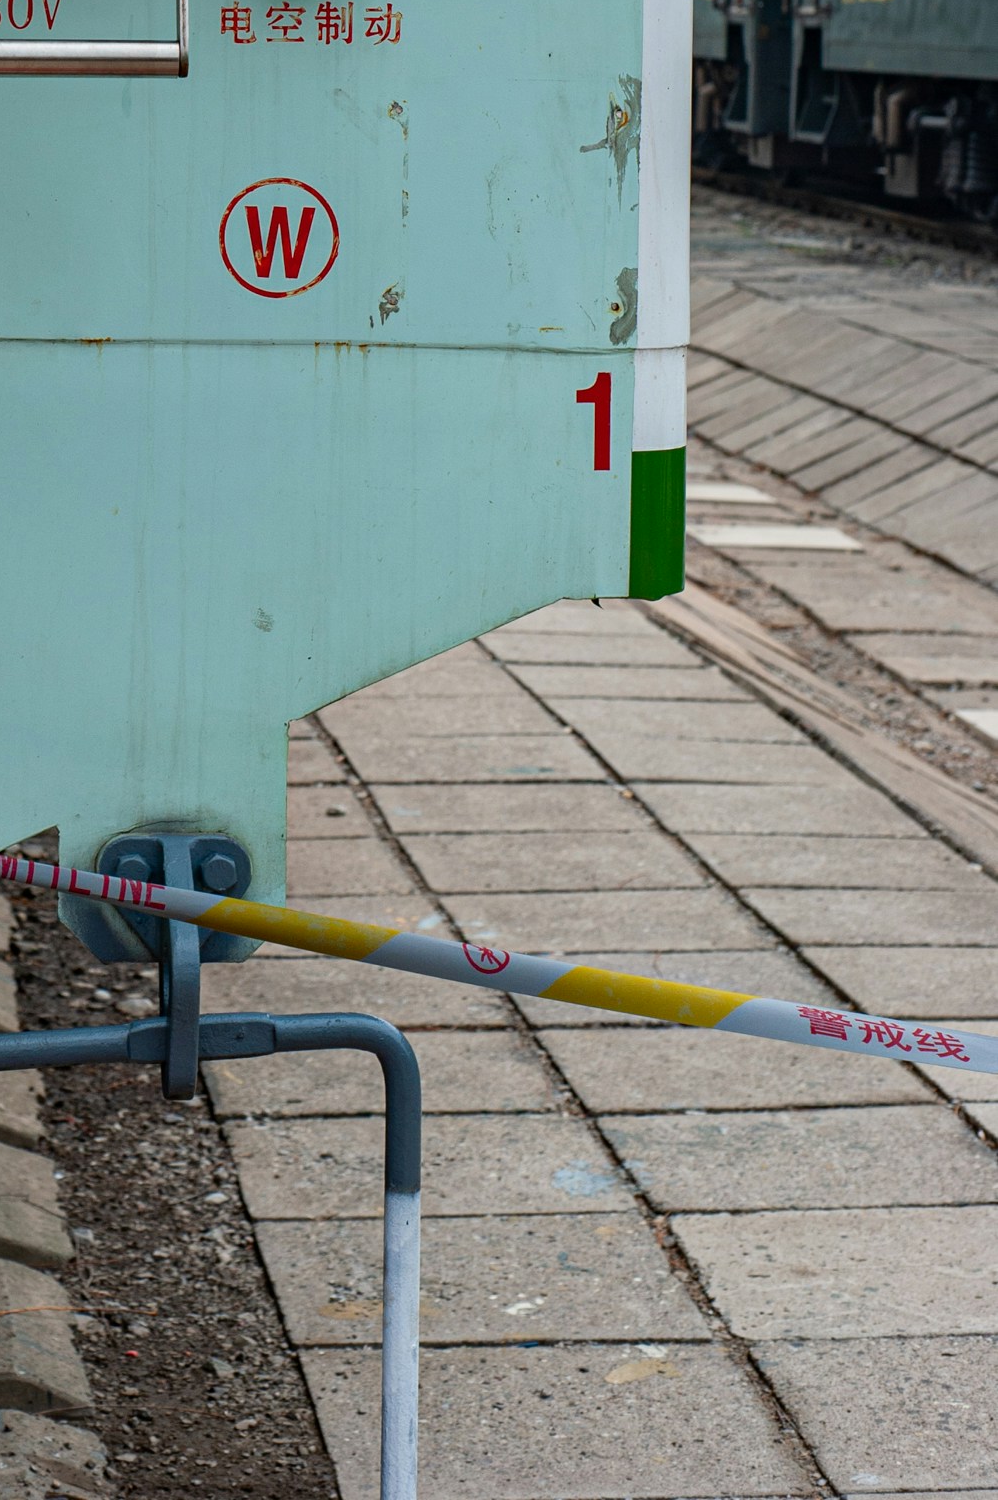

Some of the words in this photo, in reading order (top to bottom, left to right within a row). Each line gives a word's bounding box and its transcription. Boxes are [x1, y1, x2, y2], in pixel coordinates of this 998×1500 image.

[221, 1, 402, 45] 电空制动
[245, 206, 316, 279] W
[576, 372, 611, 471] 1
[796, 1005, 971, 1063] 警戒线
